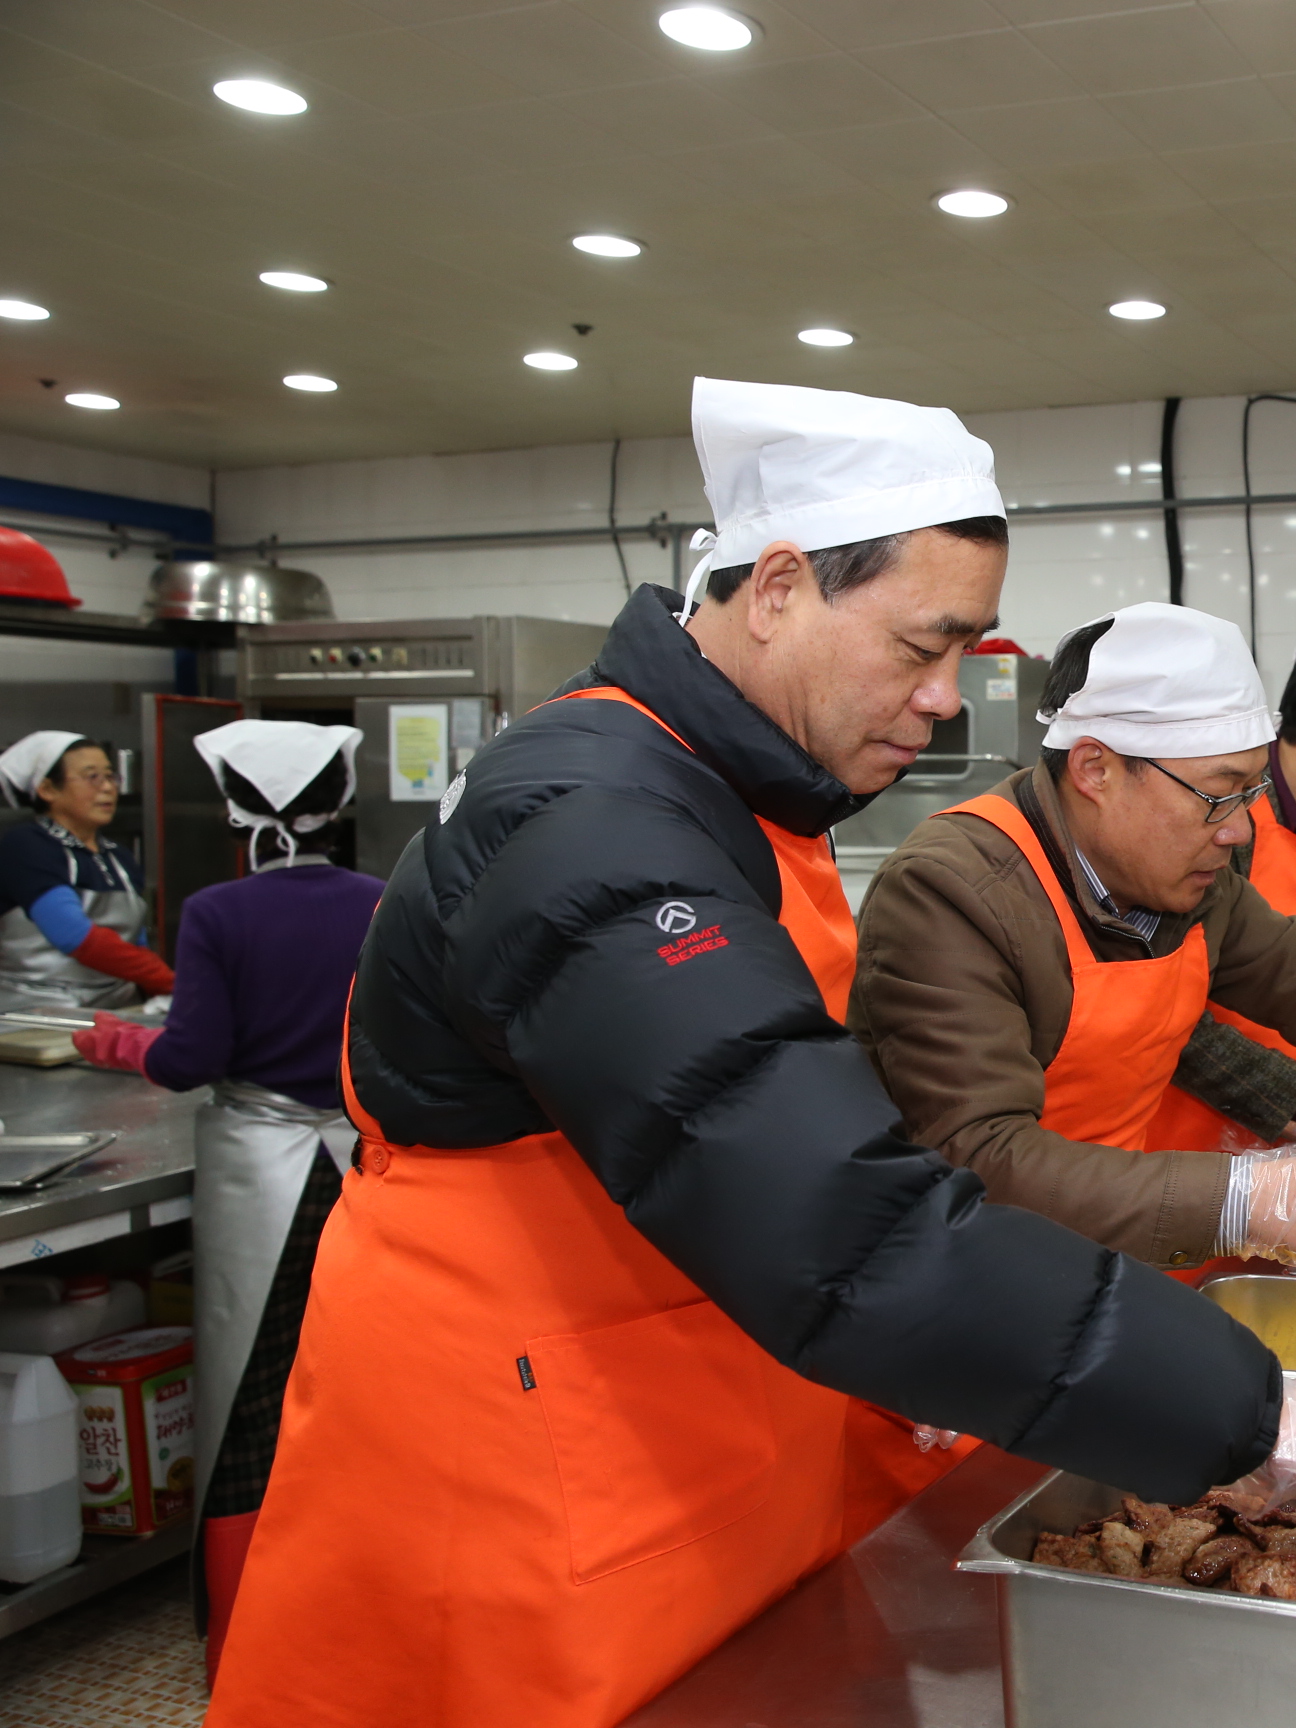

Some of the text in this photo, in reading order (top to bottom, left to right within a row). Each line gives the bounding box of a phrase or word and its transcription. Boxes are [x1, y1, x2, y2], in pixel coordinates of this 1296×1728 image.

[657, 925, 721, 958] SUMMIT
[666, 936, 730, 967] SERIES
[80, 1426, 122, 1455] 알찬
